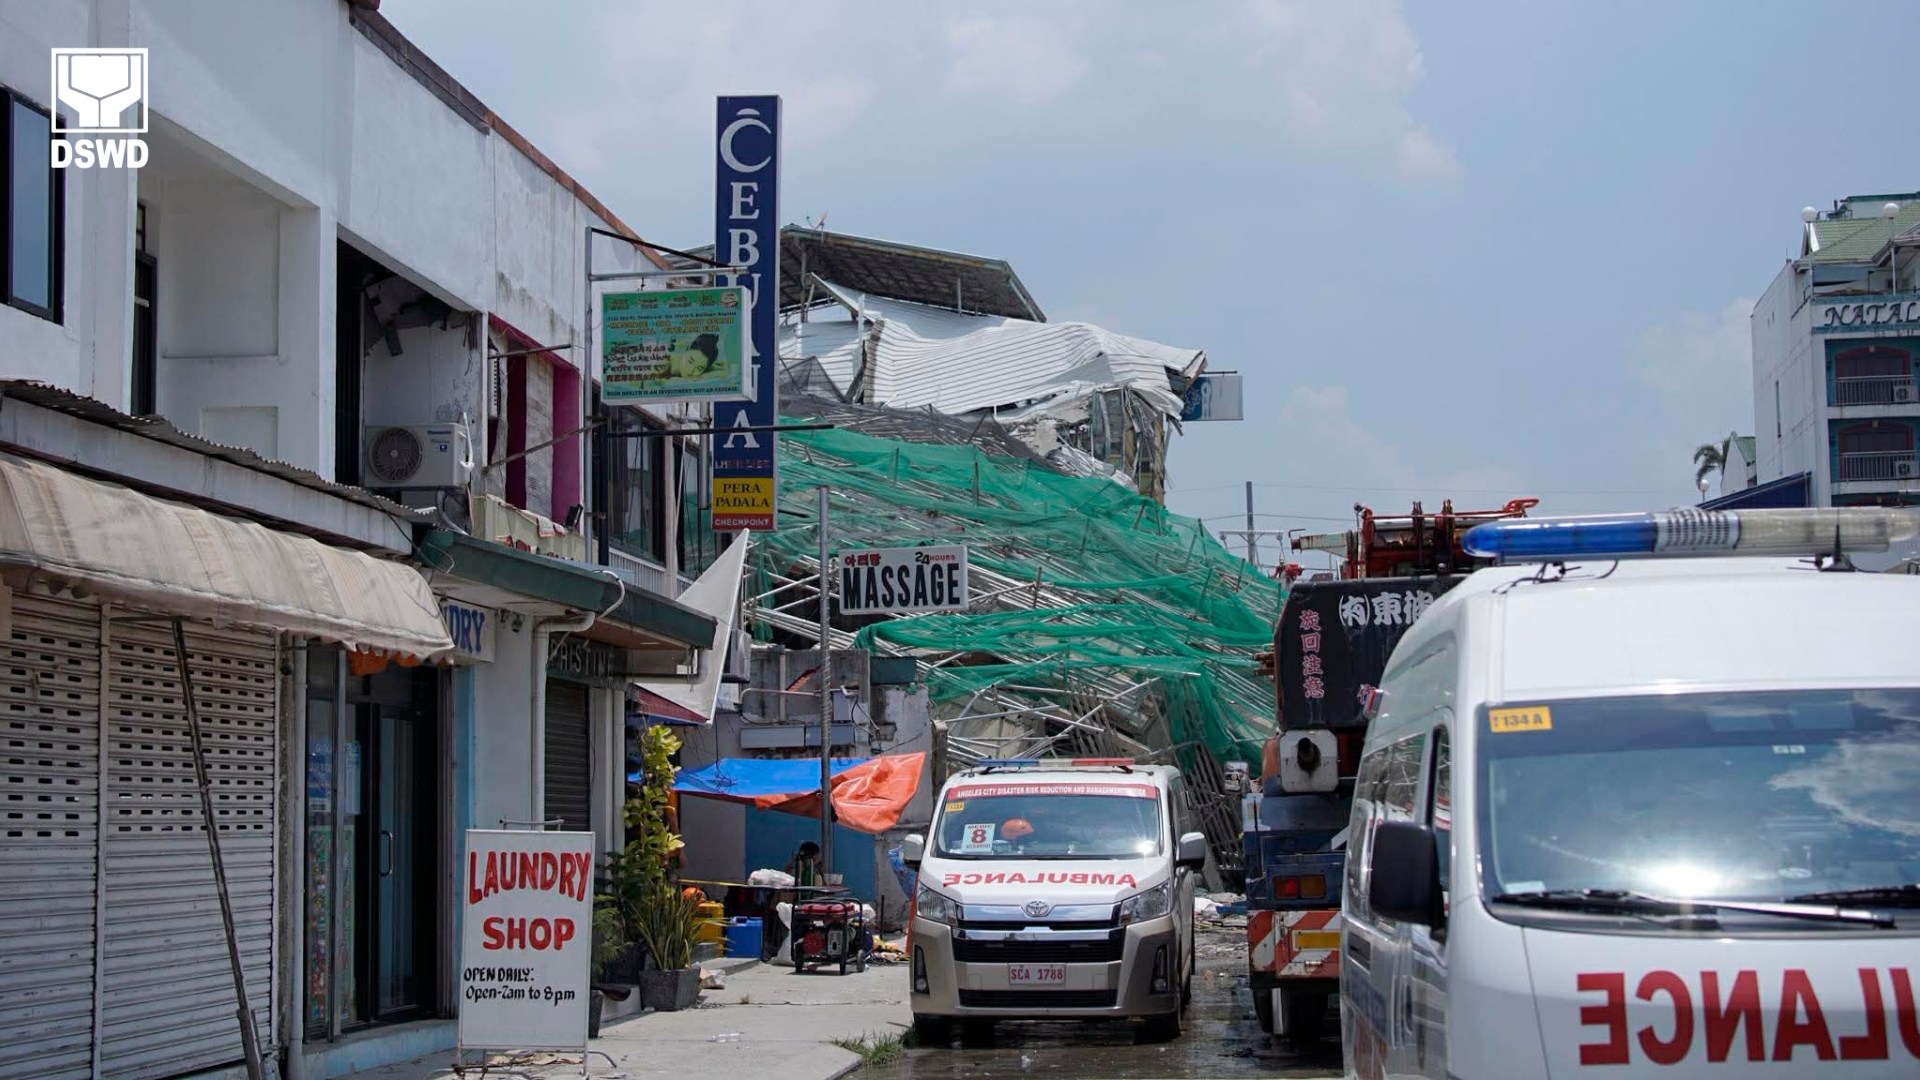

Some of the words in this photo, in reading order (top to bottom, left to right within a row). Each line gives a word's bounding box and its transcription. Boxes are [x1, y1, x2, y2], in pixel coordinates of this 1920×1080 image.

[723, 483, 762, 494] PERA
[715, 497, 769, 508] PADALA
[843, 563, 960, 610] MASSAGE
[444, 604, 486, 654] DRY
[956, 789, 982, 798] ANGELES
[983, 788, 996, 796] CITY
[998, 787, 1024, 796] DISASTER
[1040, 786, 1072, 794] REDUCTION
[971, 829, 987, 844] 8
[469, 851, 592, 905] LAUNDRY
[482, 916, 576, 950] SHOP
[464, 968, 496, 982] OPEN
[1011, 968, 1030, 980] SCA
[1037, 968, 1063, 980] 1788
[528, 986, 540, 1000] to
[544, 986, 576, 1006] 8pm
